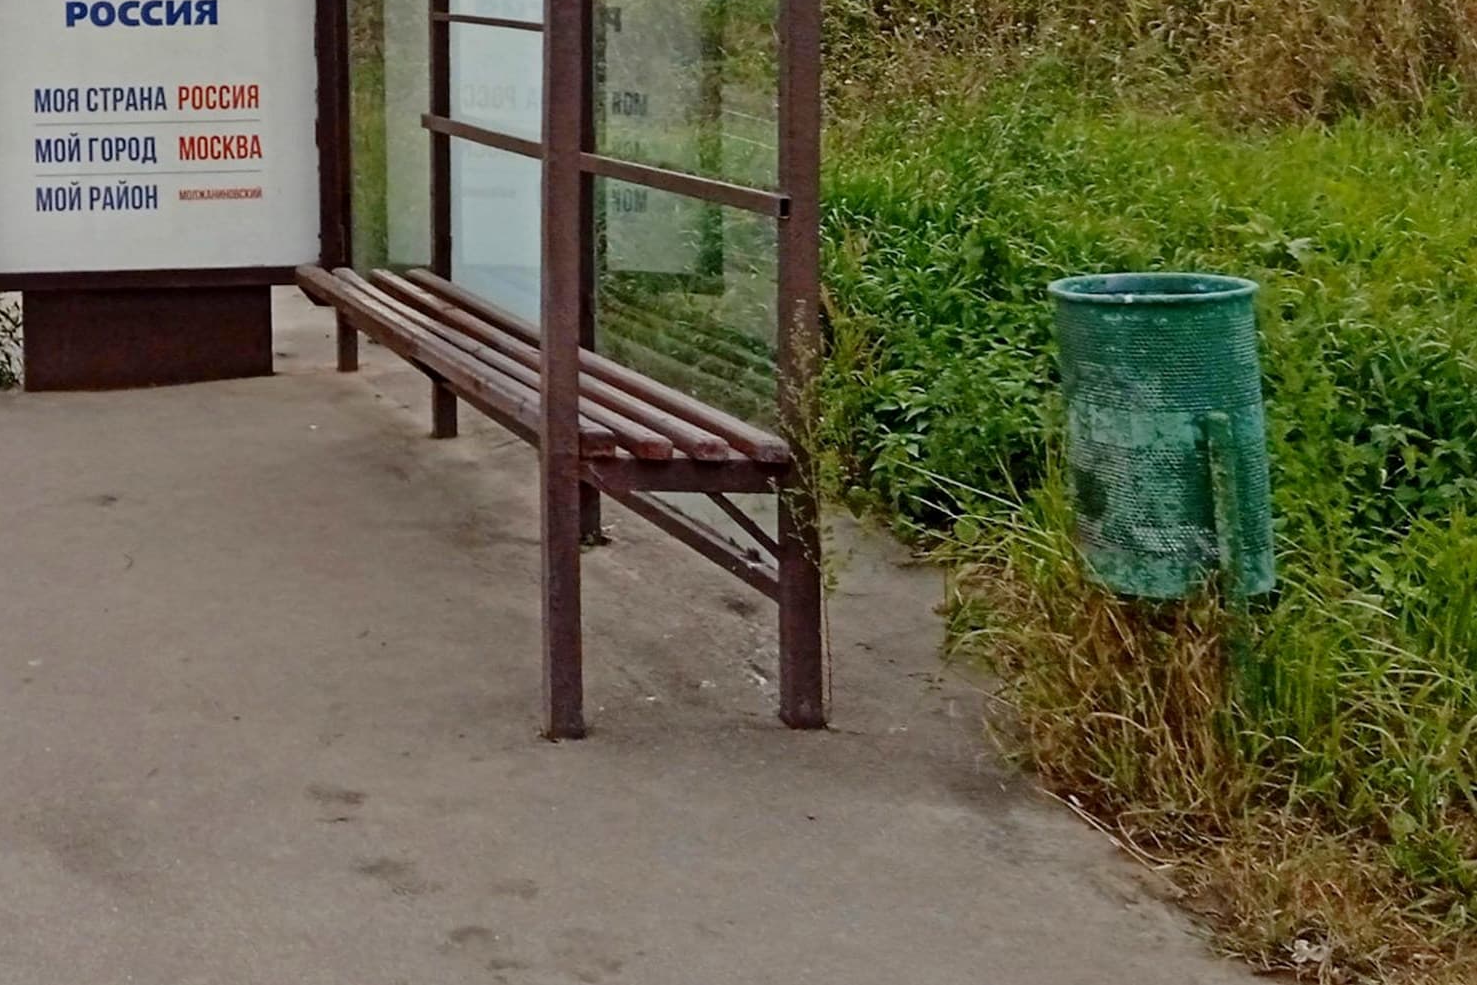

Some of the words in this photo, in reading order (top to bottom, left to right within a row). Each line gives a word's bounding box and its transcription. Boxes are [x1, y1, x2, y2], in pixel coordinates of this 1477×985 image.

[65, 0, 219, 28] РОССИЯ
[34, 88, 79, 113] МОЯ
[86, 86, 167, 112] СТРАНА
[178, 84, 260, 110] РОССИЯ
[35, 132, 81, 163] МОЙ
[88, 136, 157, 164] ГОРОД
[179, 134, 263, 161] МОСКВА
[35, 181, 82, 212] МОЙ
[88, 180, 158, 212] РАЙОН
[178, 185, 263, 201] МОЛЖАНИНОВСКИЙ
